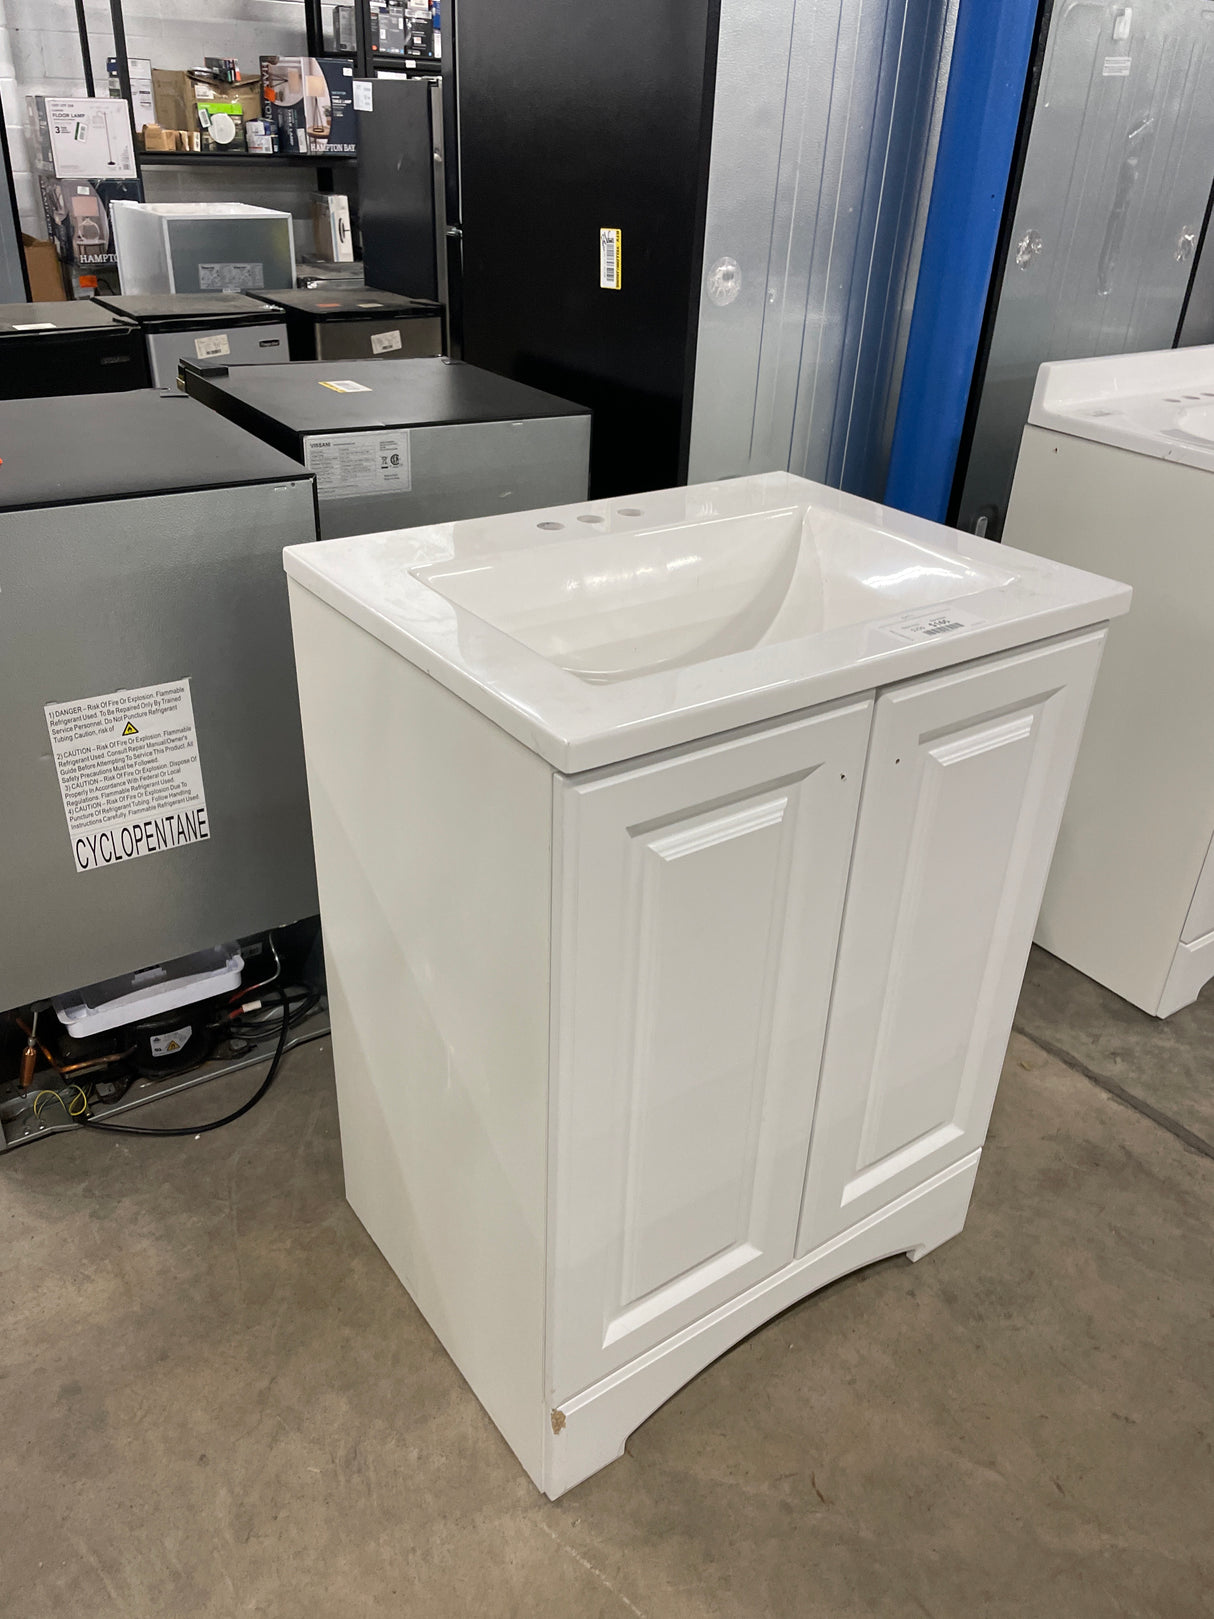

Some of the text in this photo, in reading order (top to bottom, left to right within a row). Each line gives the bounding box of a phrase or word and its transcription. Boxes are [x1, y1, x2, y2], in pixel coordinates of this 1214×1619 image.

[310, 143, 356, 152] HAMPTON BAY
[50, 715, 82, 727] Refrigerant
[115, 704, 140, 714] Repaired
[162, 695, 181, 704] Trained
[55, 706, 82, 717] DANGER
[87, 703, 99, 711] Risk
[156, 687, 184, 697] Flammable
[52, 727, 73, 735] Service
[123, 712, 147, 720] Puncture
[148, 704, 178, 716] Refrigerant
[54, 735, 73, 744] Tubing
[64, 747, 91, 758] CAUTION
[163, 726, 192, 737] Flammable
[58, 756, 89, 768] Refrigerant
[107, 747, 128, 757] Consult
[128, 744, 145, 752] Repair
[60, 768, 77, 776] Guide
[96, 758, 126, 768] Attempting
[133, 752, 153, 760] Service
[61, 775, 80, 783] Safety
[80, 768, 112, 779] Precautions
[113, 764, 126, 772] Must
[64, 790, 88, 799] Properly
[95, 782, 126, 792] Accordance
[140, 772, 160, 782] Federal
[72, 778, 99, 789] CAUTION
[75, 802, 102, 813] CAUTION
[144, 787, 169, 796] Explosion
[101, 788, 130, 799] Flammable
[131, 780, 160, 792] Refrigerant
[69, 813, 94, 822] Puncture
[102, 803, 132, 814] Refrigerant
[169, 790, 192, 798] Handling
[71, 819, 102, 830] Instructions
[128, 805, 156, 816] Flammable
[157, 797, 186, 809] Refrigerant
[74, 808, 208, 869] CYCLOPENTANE
